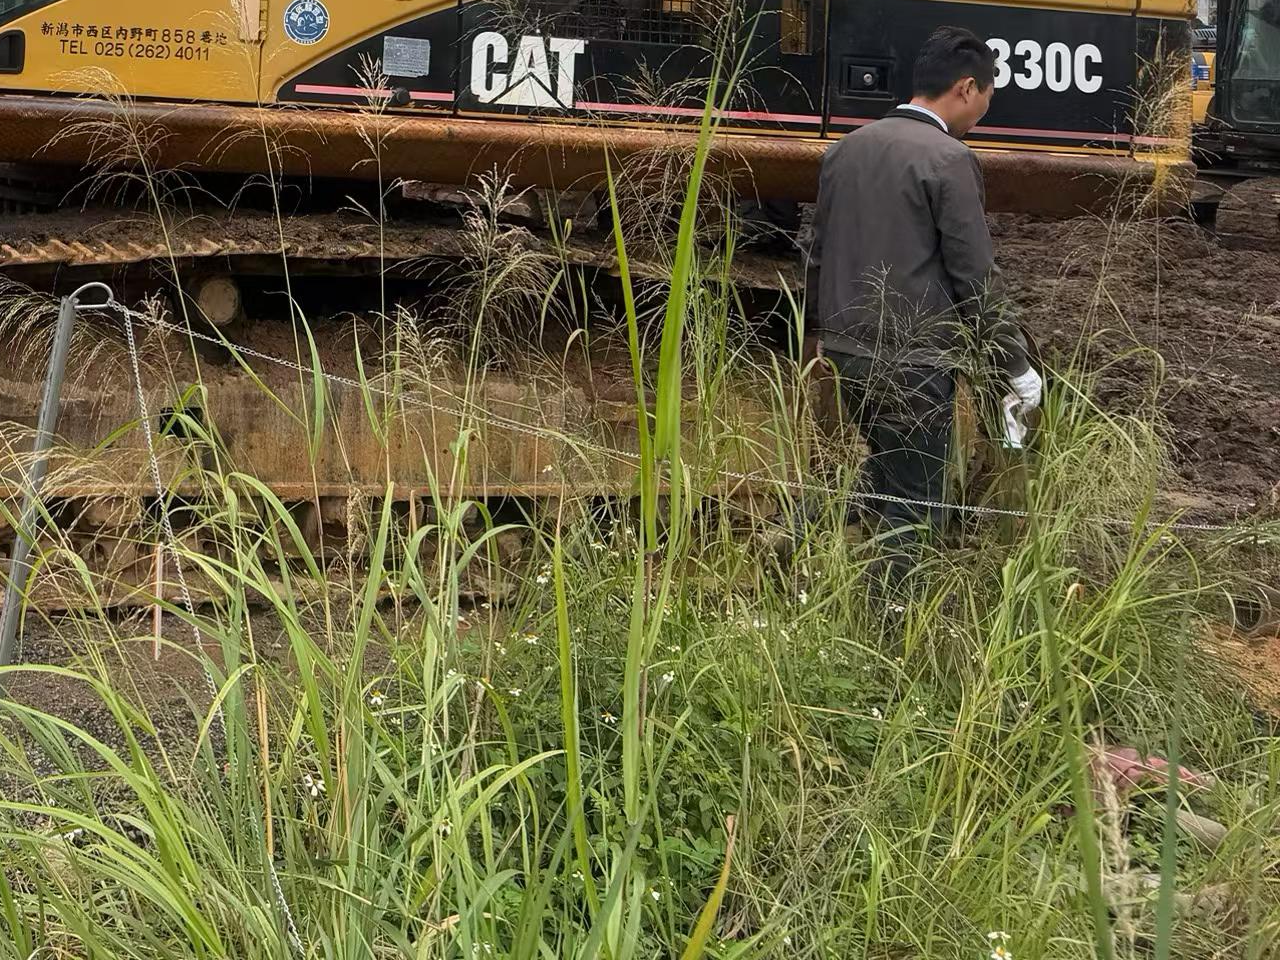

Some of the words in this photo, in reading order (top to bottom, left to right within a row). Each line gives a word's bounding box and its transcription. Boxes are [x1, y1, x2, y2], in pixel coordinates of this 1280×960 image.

[59, 39, 88, 55] TEL
[470, 31, 585, 110] CAT
[984, 38, 1104, 94] 330C
